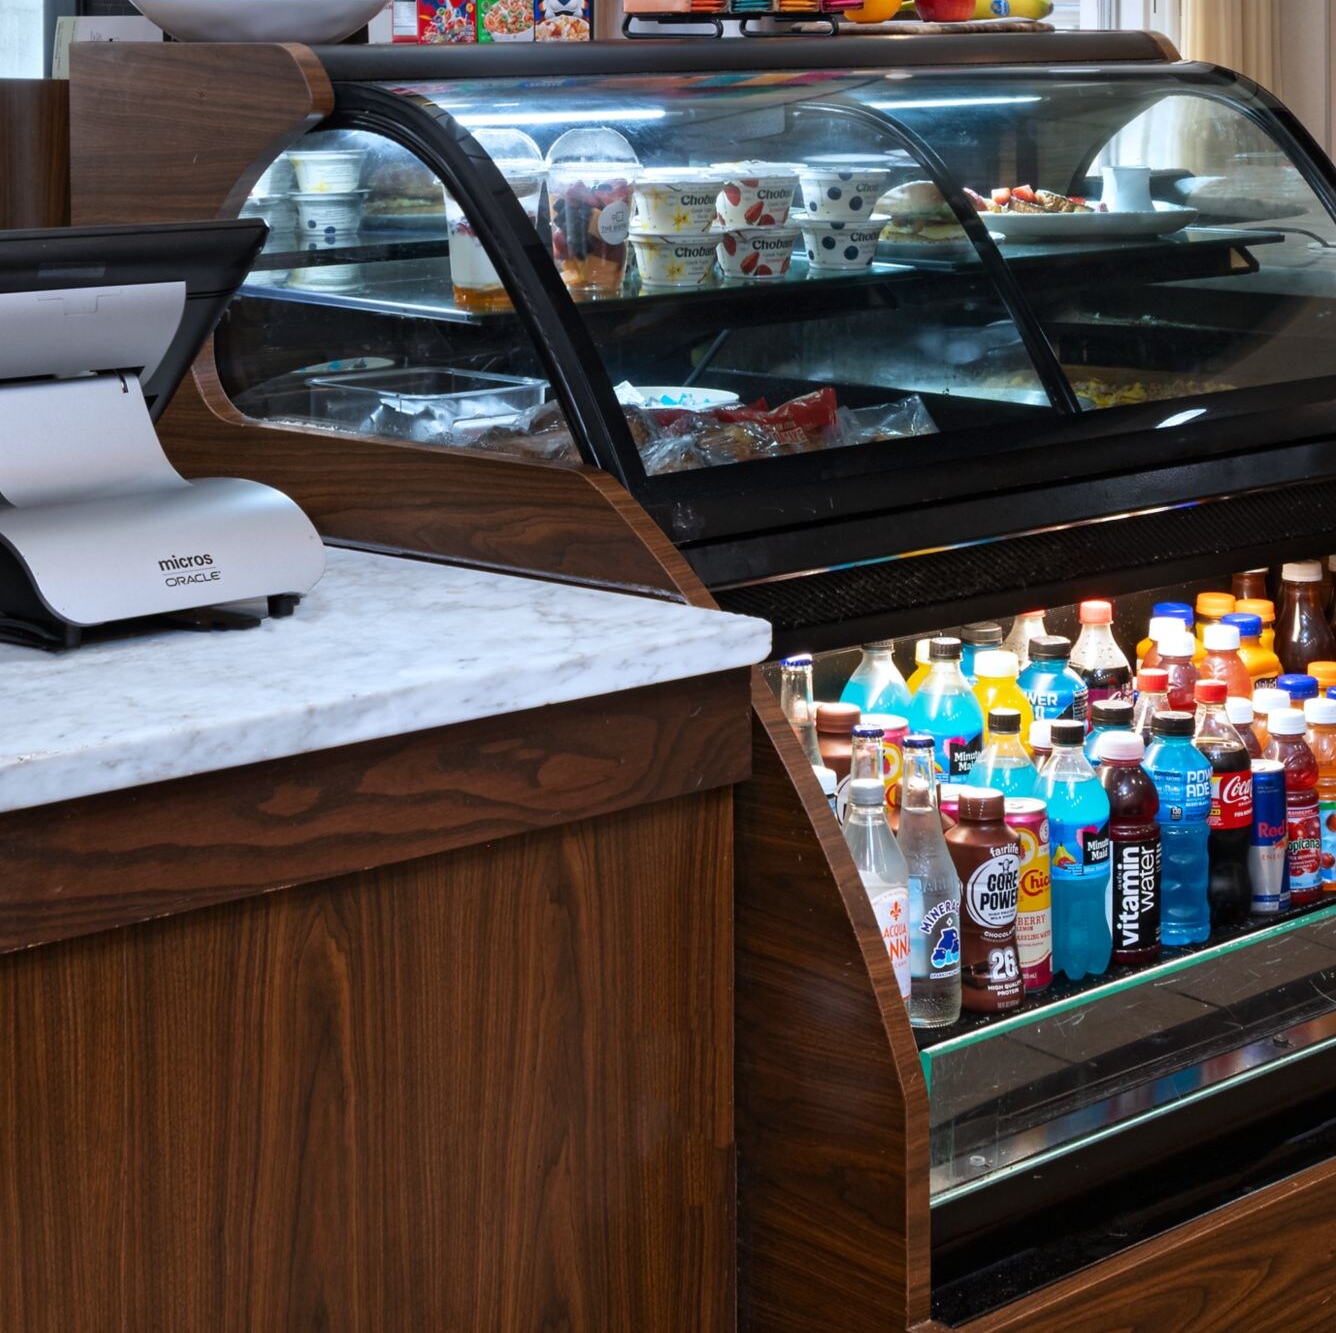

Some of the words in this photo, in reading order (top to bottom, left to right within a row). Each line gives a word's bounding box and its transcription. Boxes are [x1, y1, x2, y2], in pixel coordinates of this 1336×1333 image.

[158, 554, 213, 571] micros
[165, 571, 221, 587] ORACLE
[1186, 782, 1210, 798] ADE
[1258, 819, 1285, 838] Red
[989, 843, 1020, 858] fairlife
[1288, 838, 1320, 854] opicana
[1091, 848, 1109, 861] Maid
[987, 869, 1018, 892] CORE
[1020, 870, 1050, 897] Chic
[1140, 846, 1155, 913] water
[979, 889, 1018, 911] POWE
[1117, 847, 1139, 946] vitamin
[1017, 914, 1046, 926] BERRY
[883, 925, 907, 939] ACQUA
